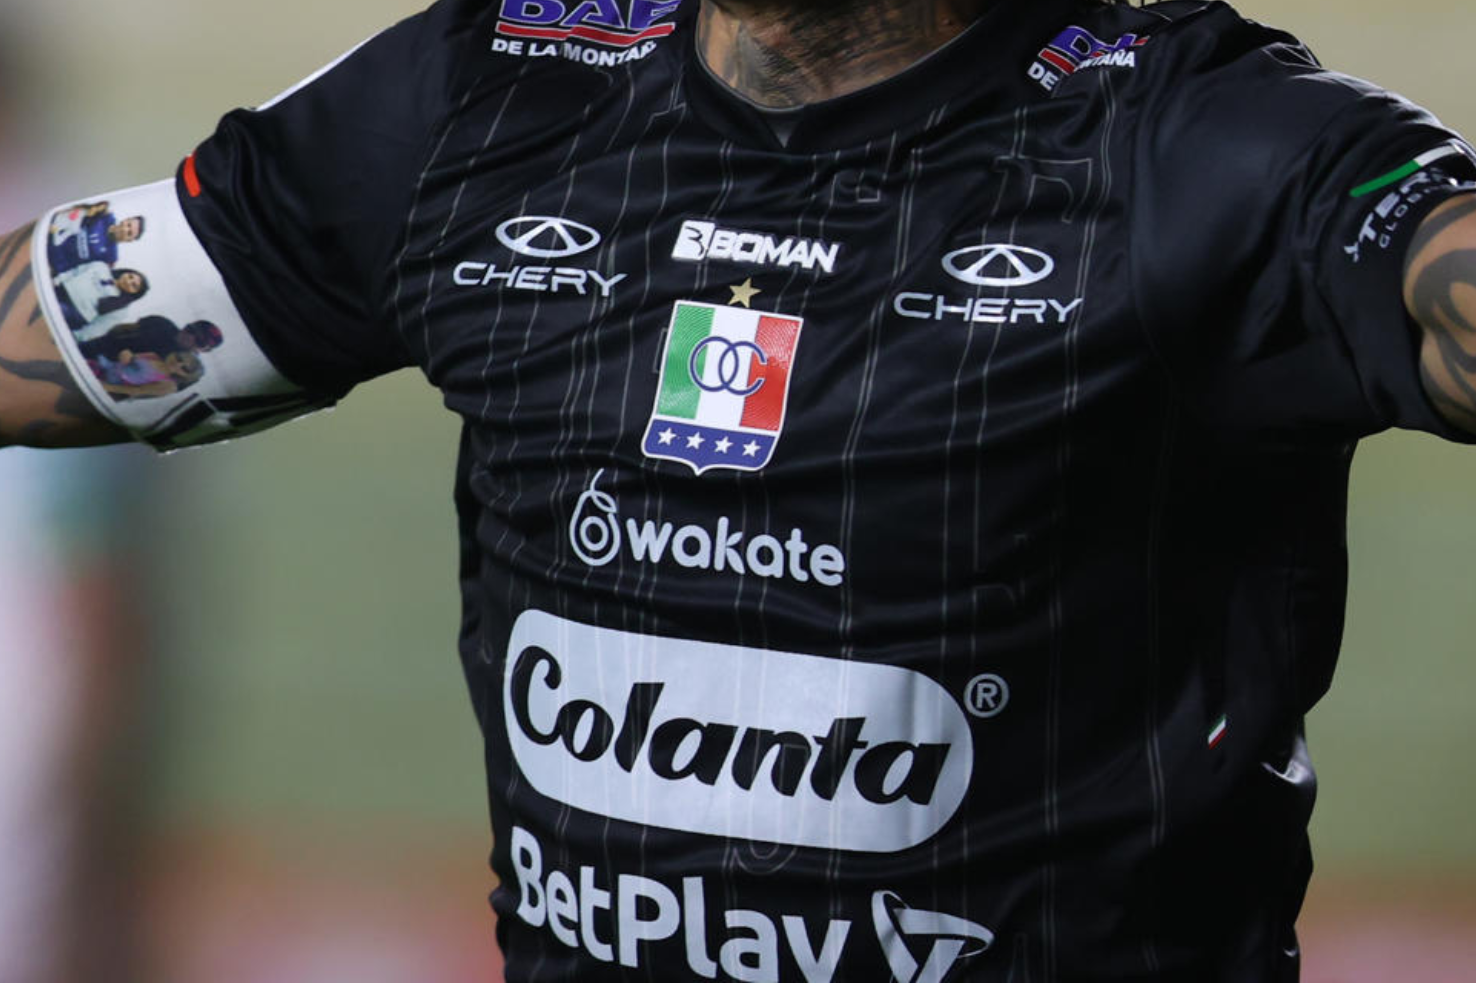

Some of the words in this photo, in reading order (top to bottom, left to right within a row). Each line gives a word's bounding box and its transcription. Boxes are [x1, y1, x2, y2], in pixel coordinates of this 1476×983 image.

[492, 39, 524, 55] DE
[528, 41, 558, 57] LA
[1027, 61, 1059, 92] DE
[706, 229, 840, 273] BOMAN
[453, 261, 629, 297] CHERY
[893, 290, 1084, 324] CHERY
[626, 516, 845, 587] wakate
[510, 645, 952, 806] Colanta
[511, 825, 852, 983] BetPlay
